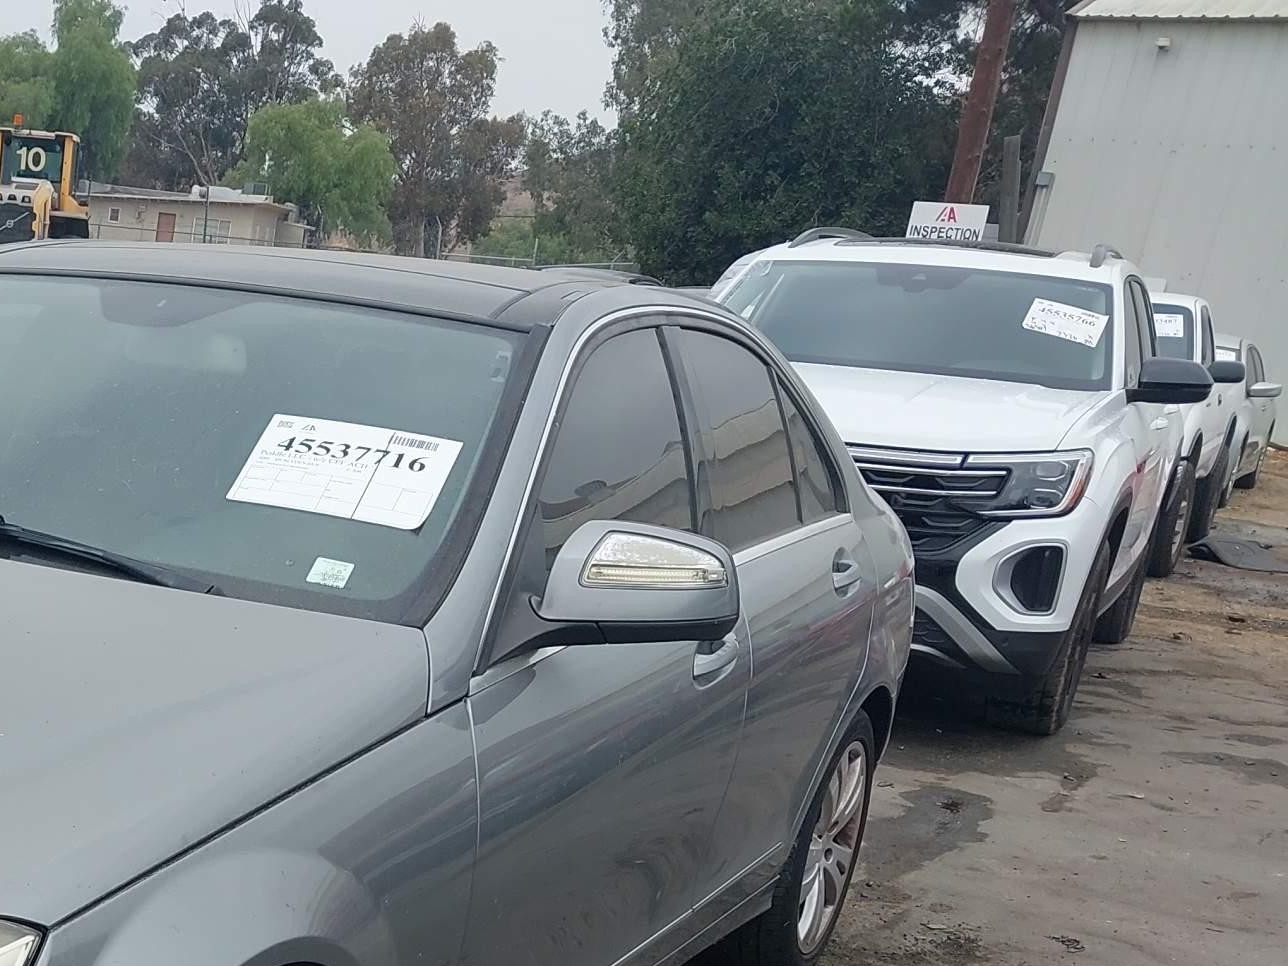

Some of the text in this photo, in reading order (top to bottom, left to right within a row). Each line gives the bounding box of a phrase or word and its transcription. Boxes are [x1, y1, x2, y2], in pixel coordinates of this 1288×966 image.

[16, 146, 46, 171] 10
[910, 225, 981, 241] INSPECTION
[277, 436, 432, 472] 45537716
